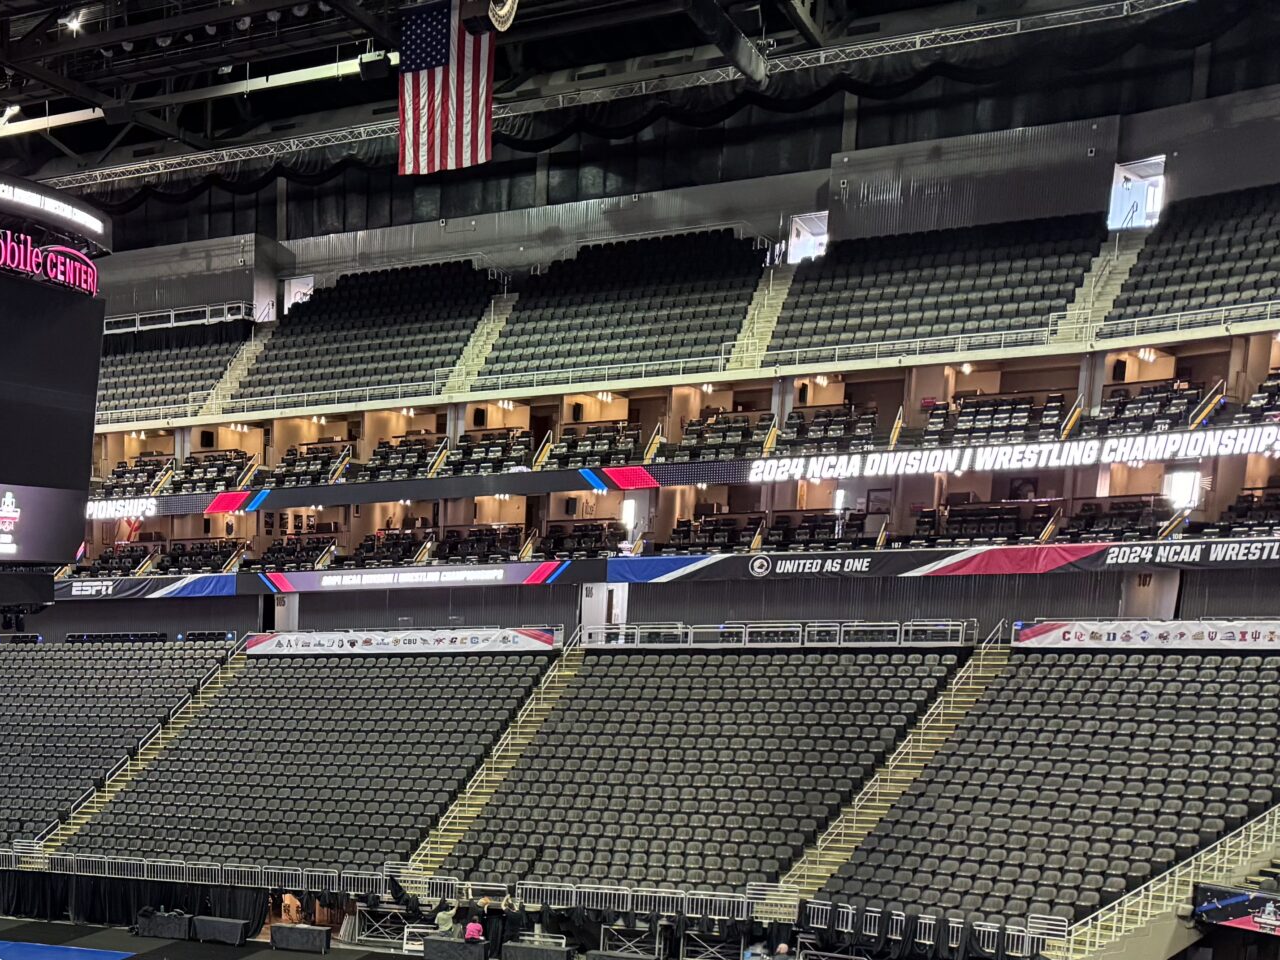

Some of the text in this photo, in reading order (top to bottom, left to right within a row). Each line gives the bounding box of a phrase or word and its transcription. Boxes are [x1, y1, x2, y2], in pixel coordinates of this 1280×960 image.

[47, 251, 94, 292] CENTER
[749, 457, 805, 483] 2024
[806, 453, 863, 479] NCAA
[863, 448, 961, 475] DIVISION
[974, 439, 1101, 471] WRESTLING
[1106, 546, 1154, 564] 2024
[776, 558, 872, 573] UNITED AS ONE
[72, 581, 114, 596] ESPN
